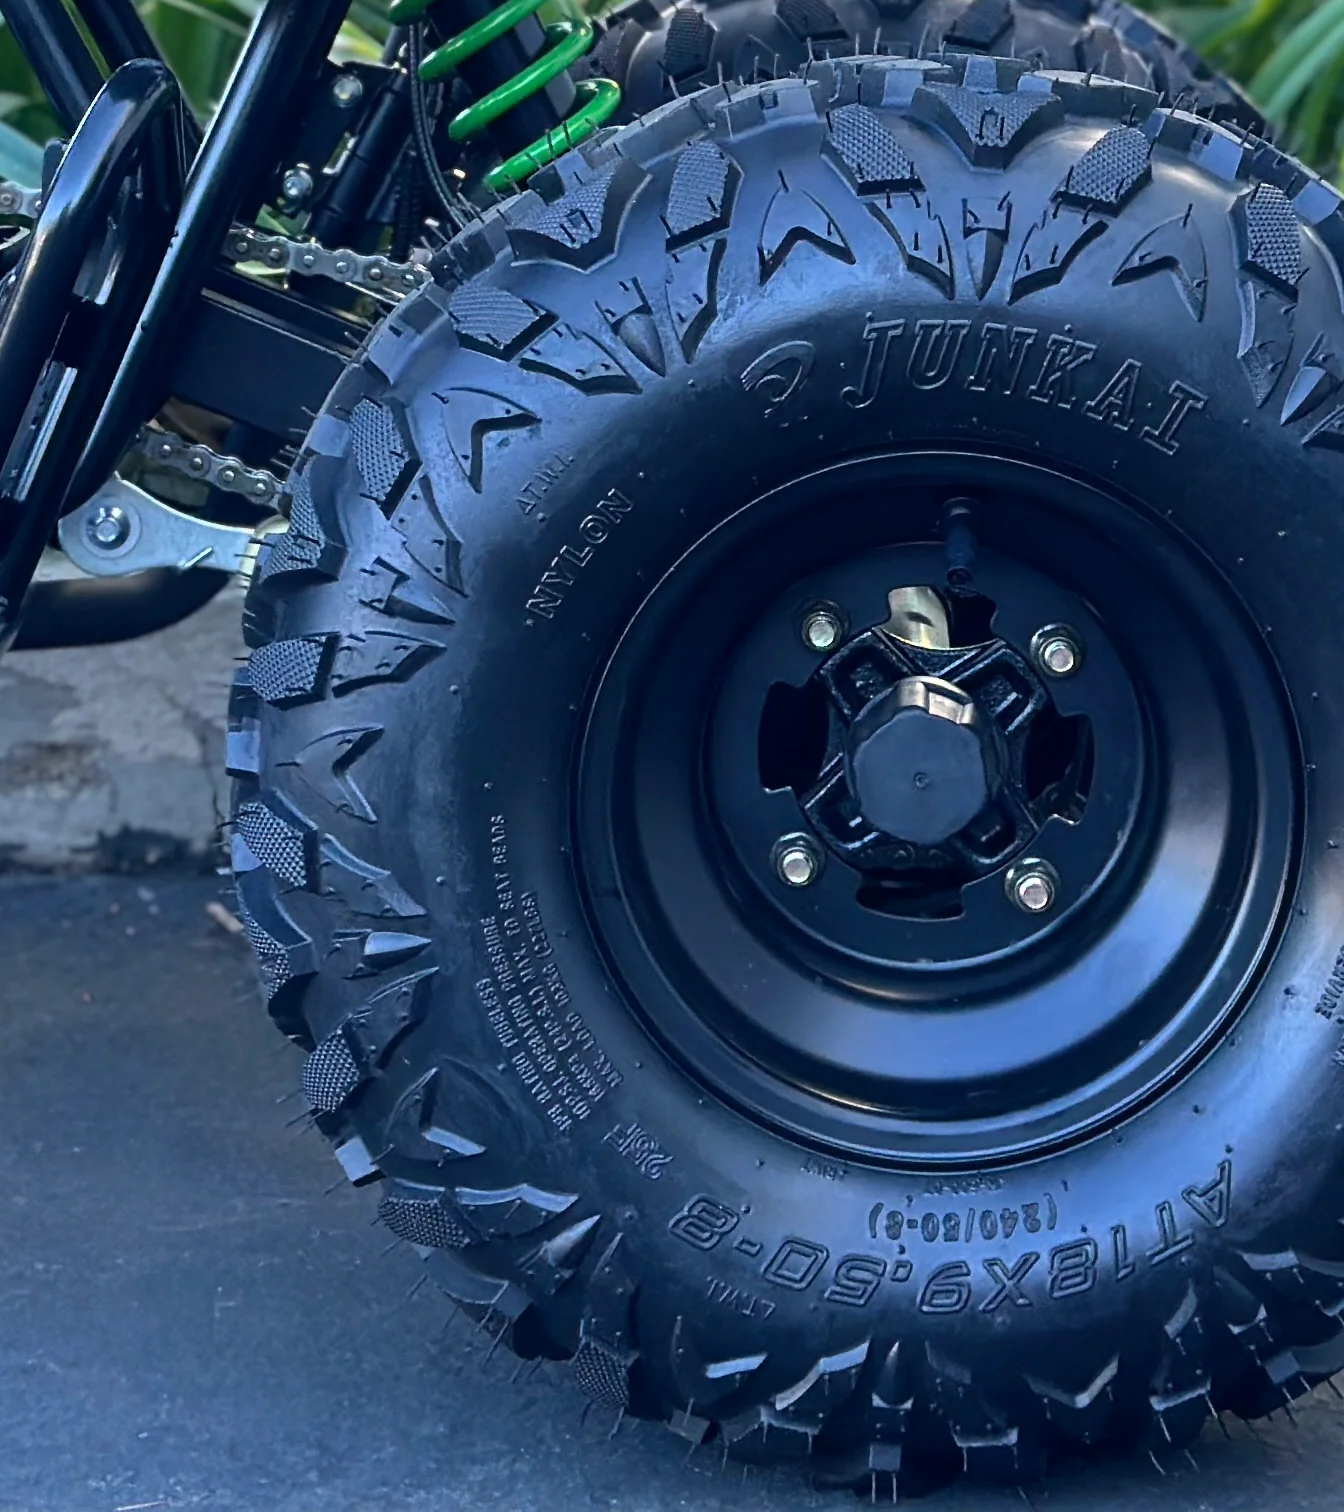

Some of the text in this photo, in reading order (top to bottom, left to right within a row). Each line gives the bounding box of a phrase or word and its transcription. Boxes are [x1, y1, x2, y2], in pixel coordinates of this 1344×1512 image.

[840, 319, 1208, 456] JUNKAI
[526, 487, 635, 620] NYLON
[494, 872, 515, 911] SEAT
[481, 915, 518, 993] PRESSURE
[476, 978, 518, 1049] TUBELESS
[508, 994, 556, 1073] OPERATING
[667, 1158, 1234, 1314] AT18X9.50-8
[869, 1194, 1060, 1242] (240/50-8)
